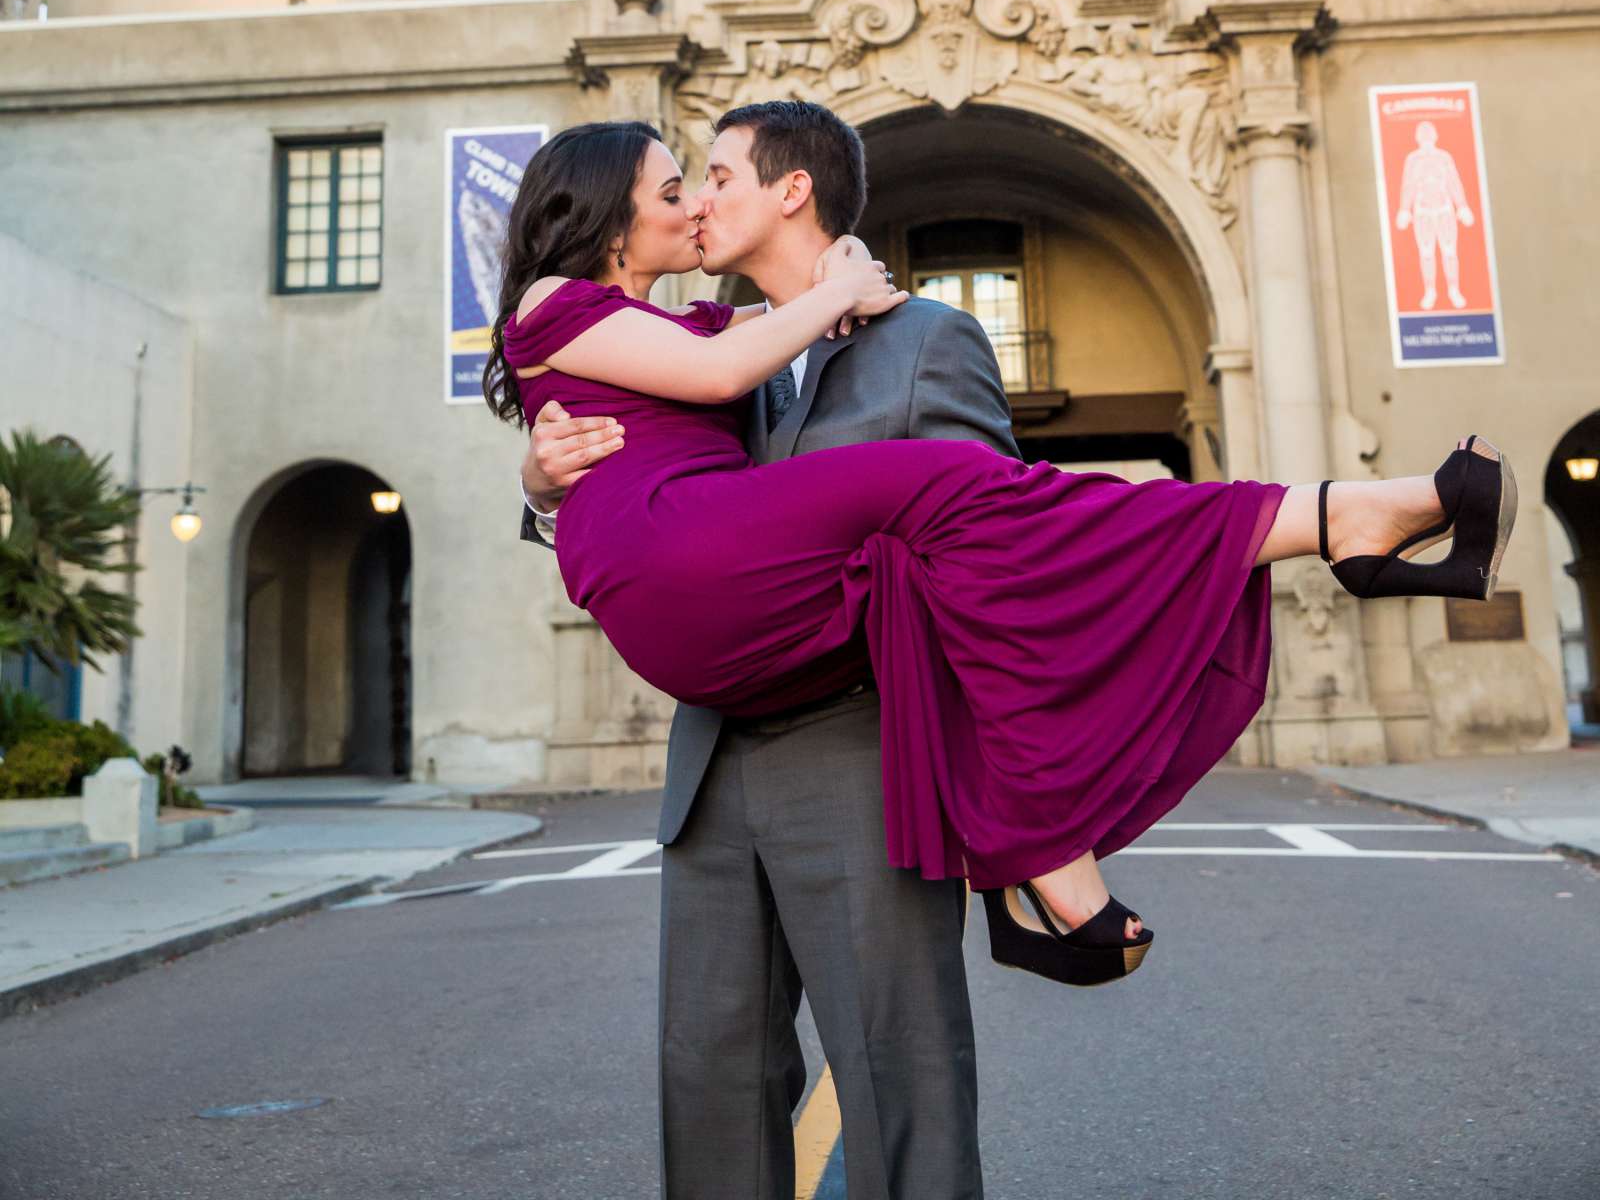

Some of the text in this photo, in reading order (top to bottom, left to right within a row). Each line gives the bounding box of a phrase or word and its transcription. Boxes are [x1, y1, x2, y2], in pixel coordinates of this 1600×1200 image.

[464, 139, 524, 184] CLIMB TH
[466, 160, 520, 203] TOWE
